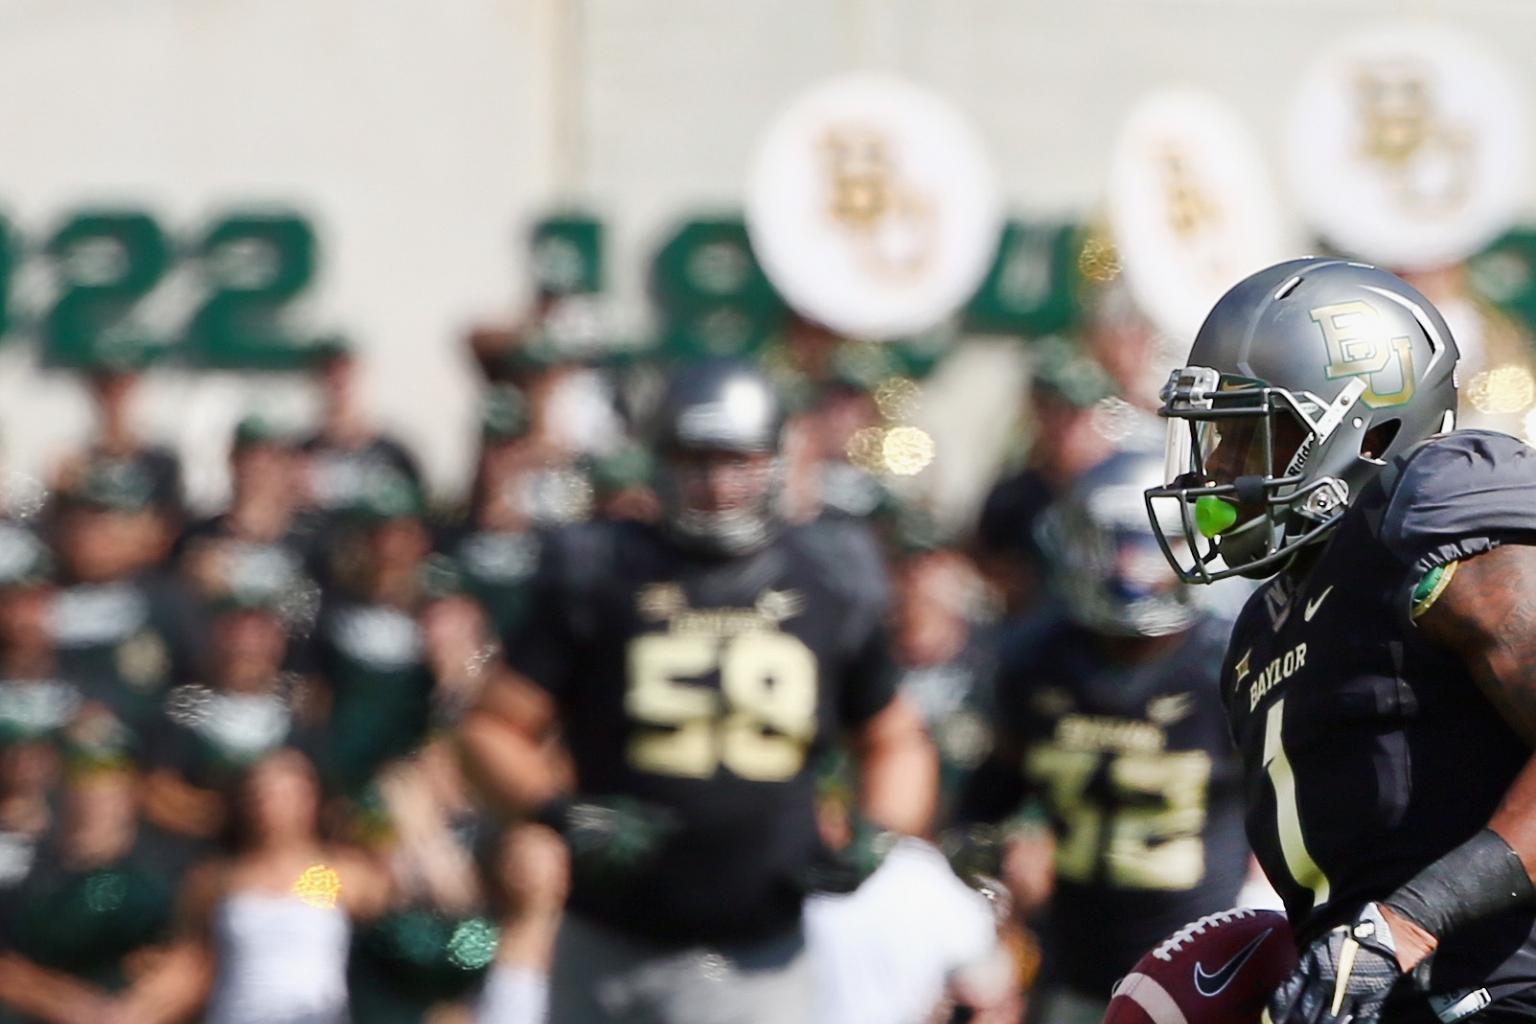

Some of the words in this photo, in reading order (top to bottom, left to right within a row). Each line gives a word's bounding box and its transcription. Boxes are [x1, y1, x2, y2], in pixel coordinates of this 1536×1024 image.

[1310, 300, 1415, 409] BU
[1250, 642, 1307, 713] BAYLOR
[1262, 697, 1331, 908] 1
